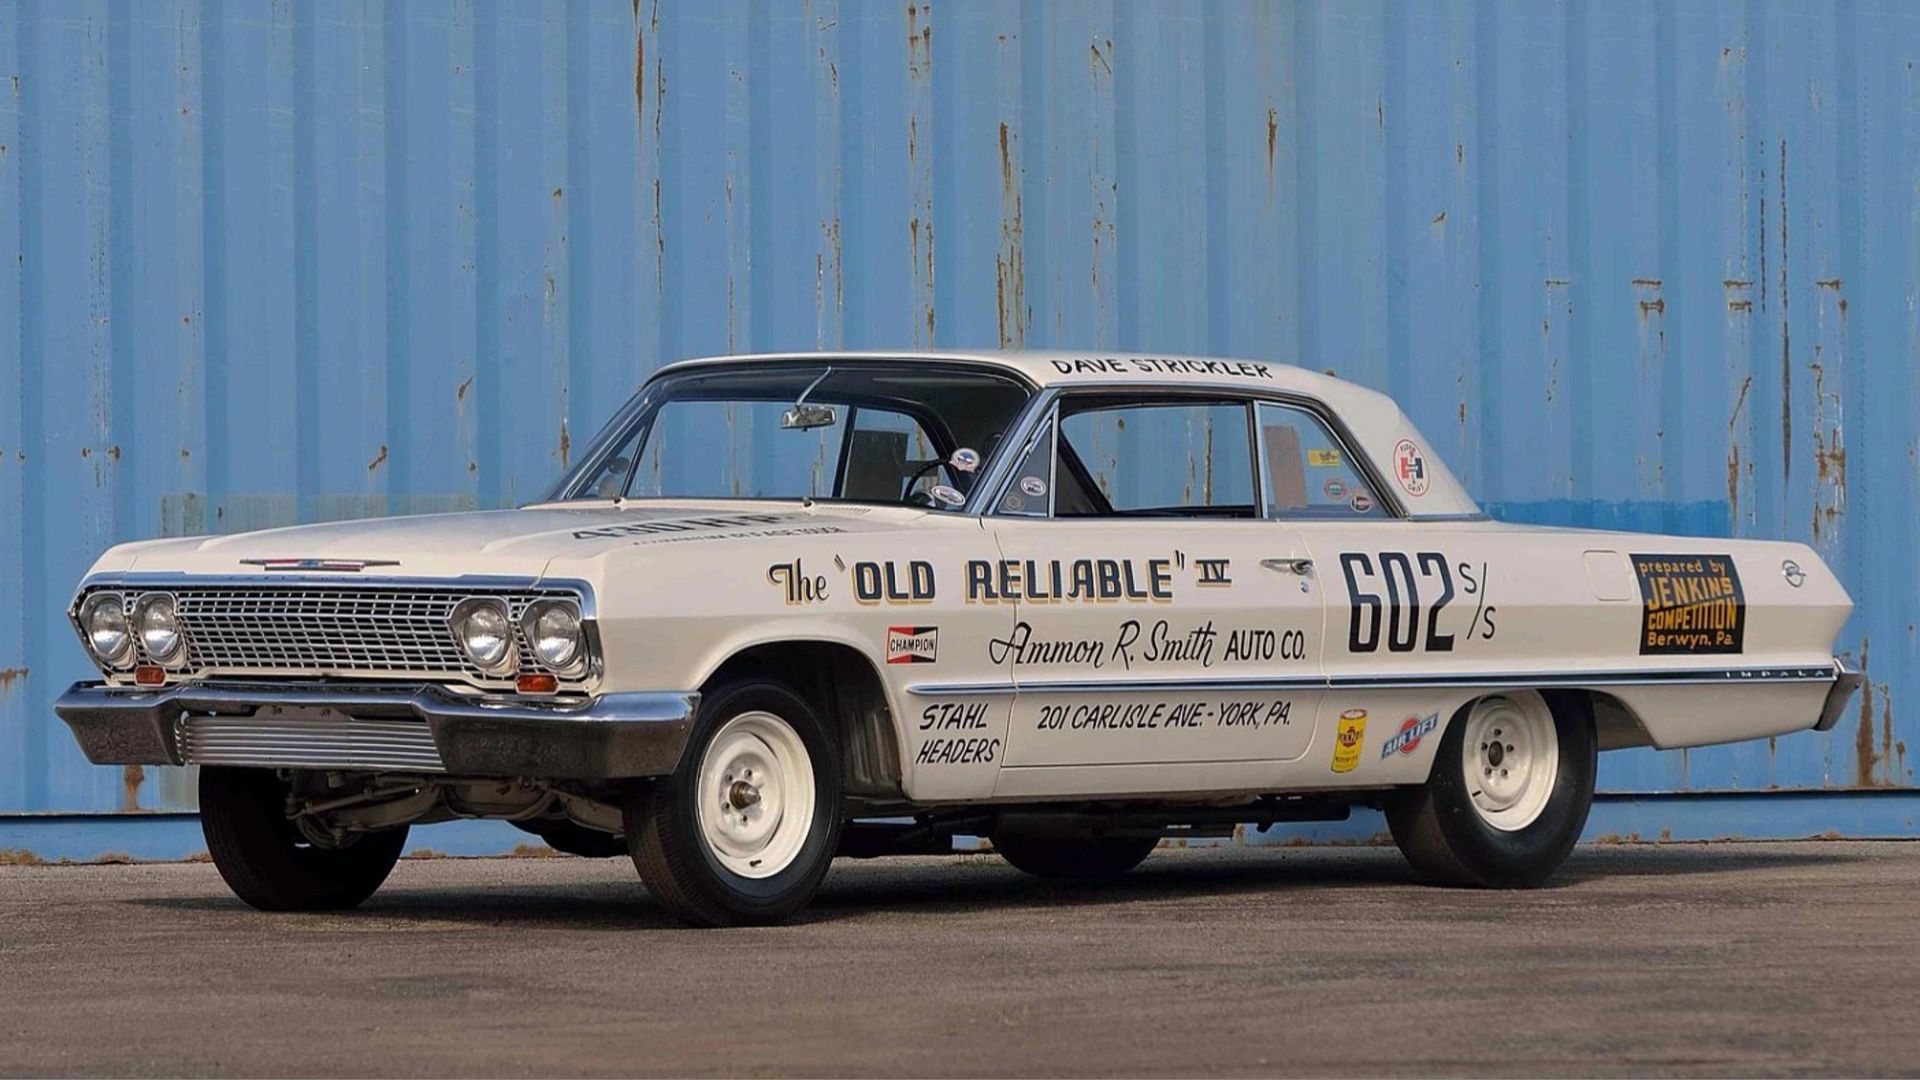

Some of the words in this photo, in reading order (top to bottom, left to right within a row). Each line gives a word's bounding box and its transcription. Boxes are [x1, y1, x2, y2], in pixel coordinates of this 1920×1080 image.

[1050, 359, 1128, 374] DAVE
[1130, 358, 1273, 379] STRICKLER
[766, 557, 831, 605] The
[1196, 558, 1232, 587] IV
[1639, 557, 1703, 577] prepared
[1709, 556, 1726, 577] by
[1339, 552, 1455, 652] 602
[1648, 576, 1734, 611] JENKINS
[1647, 596, 1736, 631] COMPETITION
[890, 638, 935, 653] CHAMPION
[988, 621, 1106, 667] Ammon
[1111, 619, 1141, 670] R.
[1143, 619, 1218, 668] Smith
[1224, 629, 1276, 661] AUTO
[1280, 629, 1307, 661] CO.
[1725, 669, 1826, 679] IMPALA
[919, 703, 989, 731] STAHL
[1037, 703, 1070, 730] 201
[1071, 703, 1163, 730] CARLISLE
[1263, 700, 1291, 727] PA.
[916, 737, 1000, 765] HEADERS
